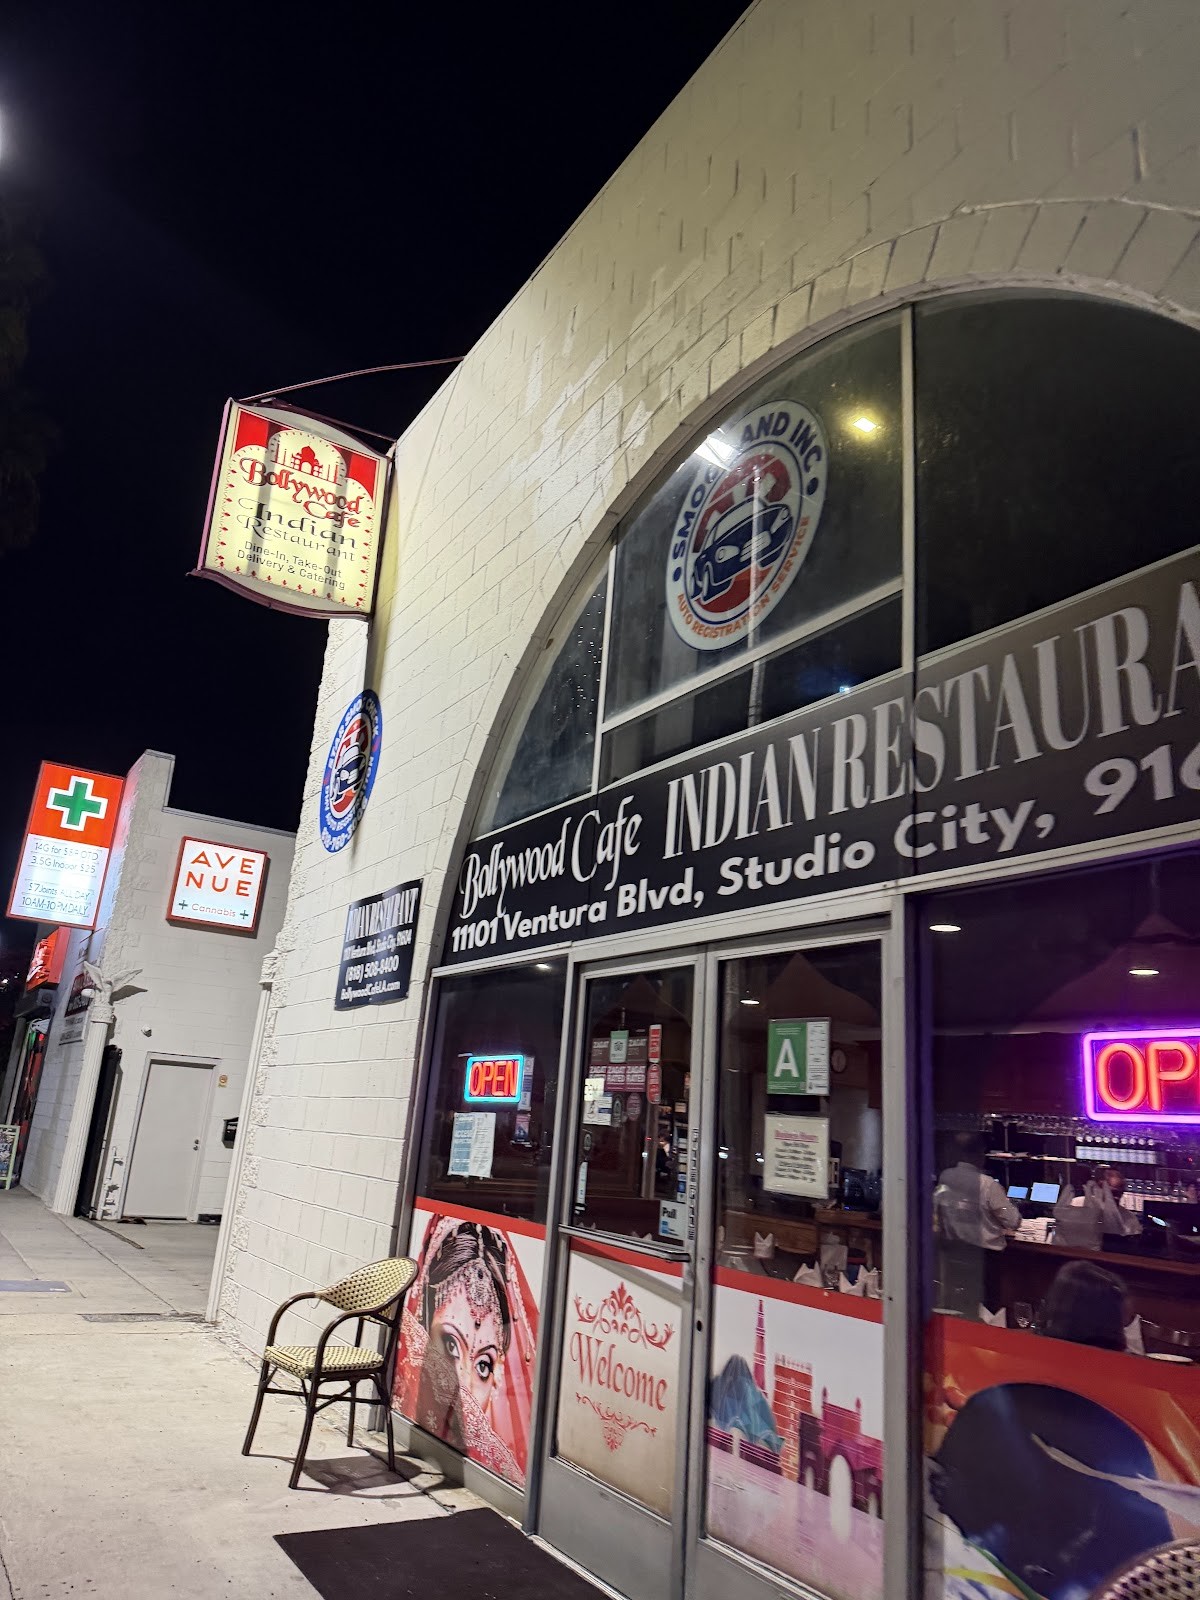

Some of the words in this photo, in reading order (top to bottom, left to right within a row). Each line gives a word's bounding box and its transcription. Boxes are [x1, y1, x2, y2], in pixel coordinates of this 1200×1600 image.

[790, 421, 822, 474] INC
[239, 457, 365, 514] Bollywood
[237, 497, 359, 549] Indian
[302, 500, 361, 529] Cafe
[236, 514, 356, 562] Restaurant
[237, 549, 284, 574] Delivery
[287, 564, 296, 574] &
[299, 567, 346, 591] Catering
[244, 540, 290, 563] Dine-In,
[292, 555, 343, 579] Take-Out
[677, 593, 694, 625] AUTO
[691, 593, 770, 639] REGISTRATON
[771, 515, 811, 593] SERVICE
[458, 816, 572, 919] Bollywood
[571, 795, 643, 891] Cafe
[662, 726, 822, 859] INDIAN
[828, 580, 1200, 815] RESTAURA
[30, 855, 52, 867] 3.5G
[190, 850, 257, 875] AVE
[451, 916, 499, 953] 11101
[503, 900, 608, 941] Ventura
[616, 866, 705, 918] Blvd,
[716, 832, 876, 897] Studio
[893, 799, 1056, 859] City,
[185, 871, 252, 898] NUE
[191, 902, 236, 918] Cannabis
[469, 1060, 519, 1097] OPEN
[774, 1038, 799, 1078] A
[1096, 1040, 1200, 1111] OP
[662, 1206, 677, 1219] Pull
[569, 1331, 668, 1411] Welcome
